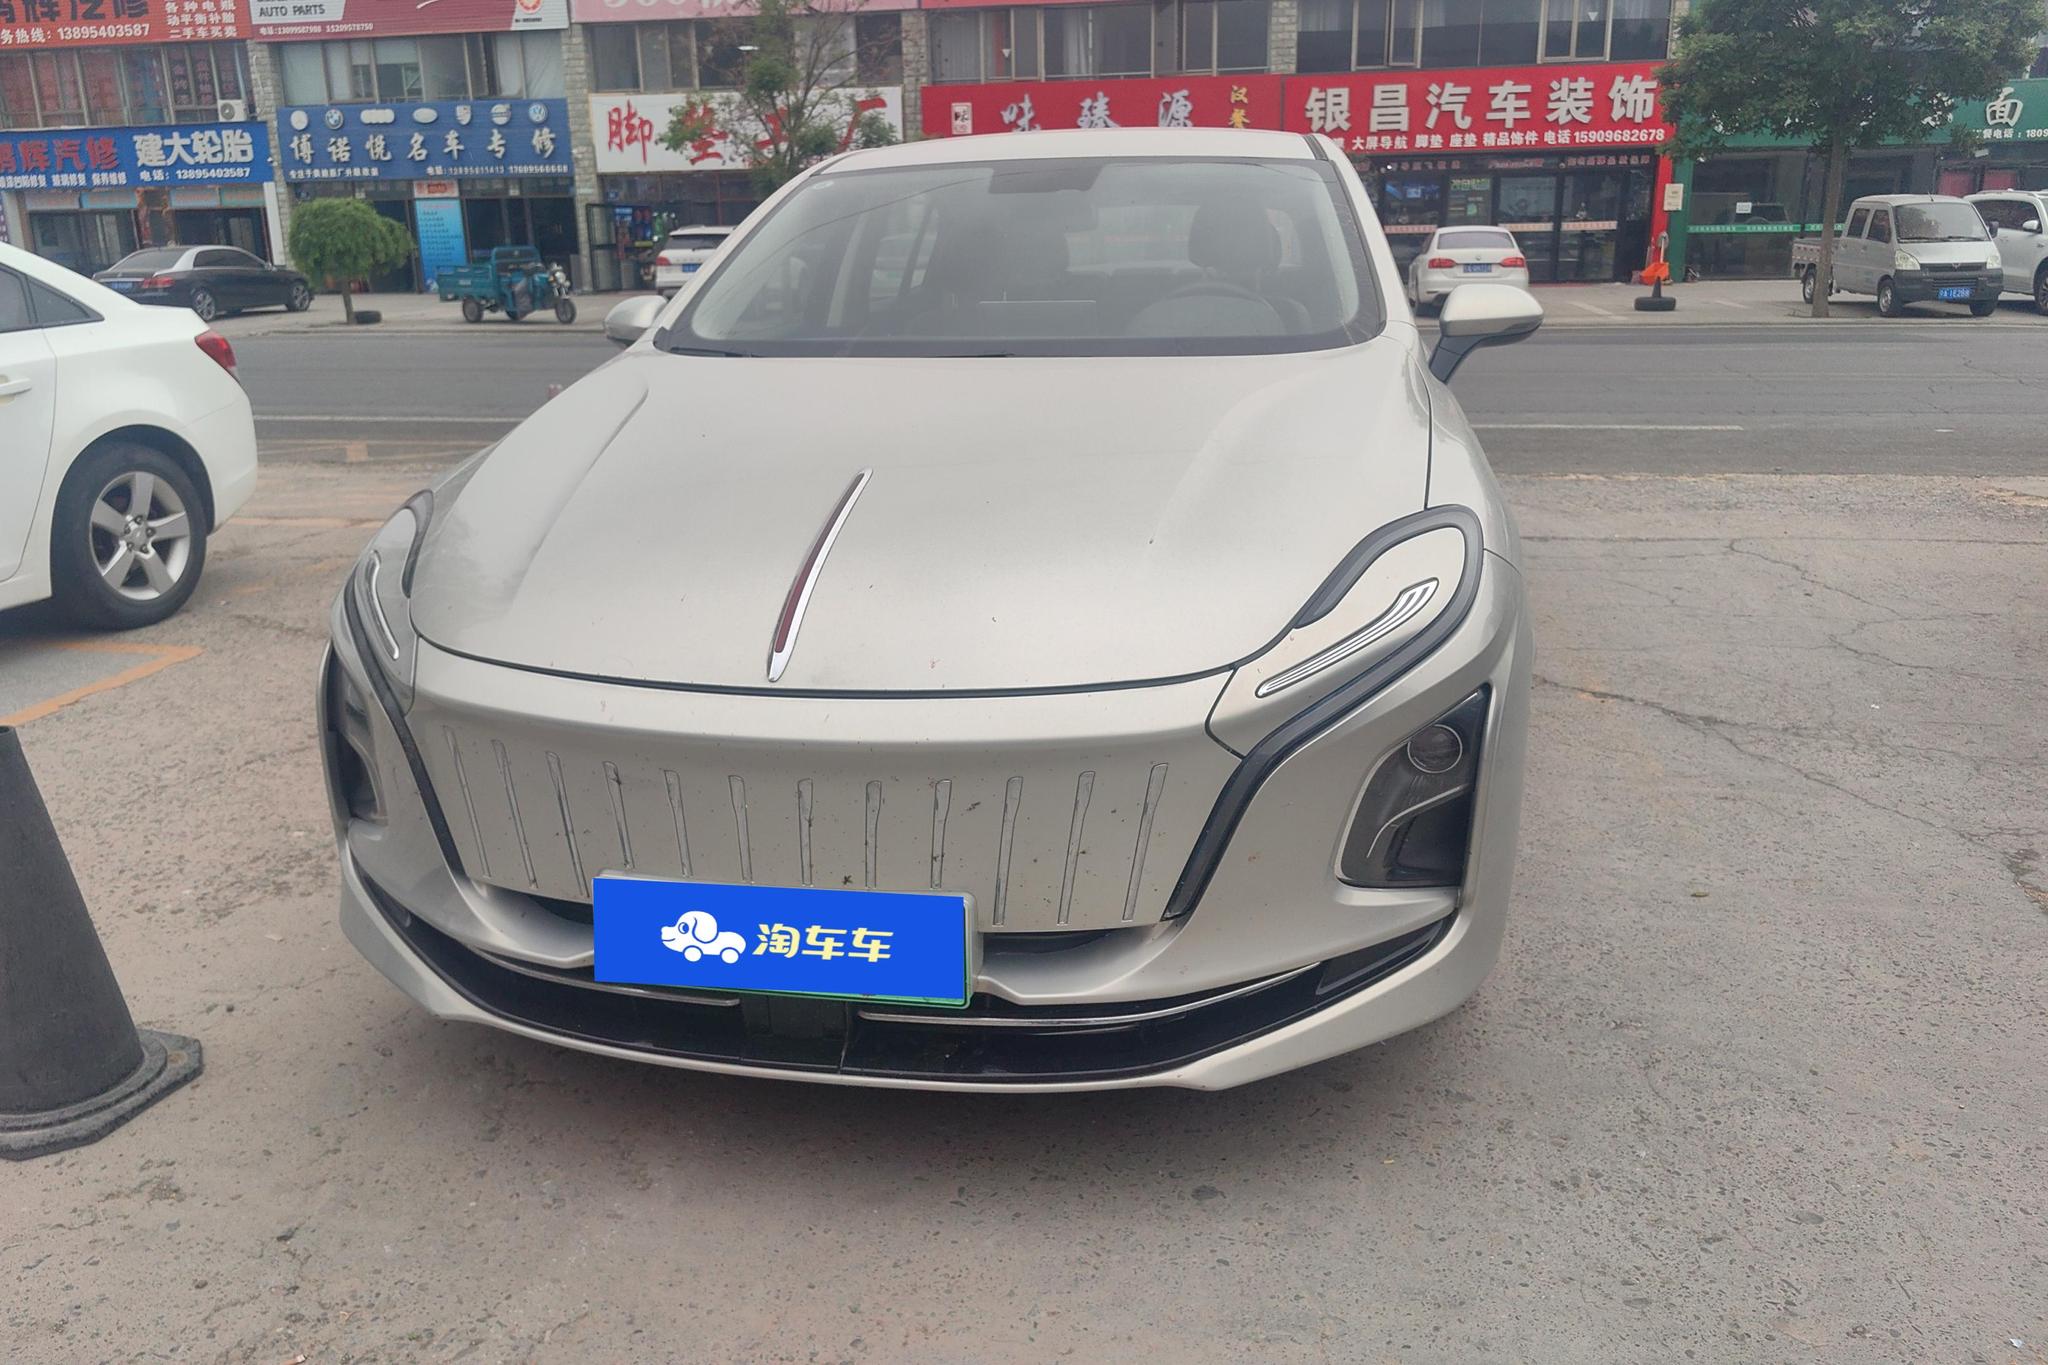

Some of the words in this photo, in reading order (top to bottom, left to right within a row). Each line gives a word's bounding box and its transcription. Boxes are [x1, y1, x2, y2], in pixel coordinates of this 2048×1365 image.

[259, 6, 288, 17] AUTO
[293, 4, 325, 15] PARTS
[1304, 74, 1658, 132] 银昌汽车装饰
[132, 129, 254, 167] 建大轮胎
